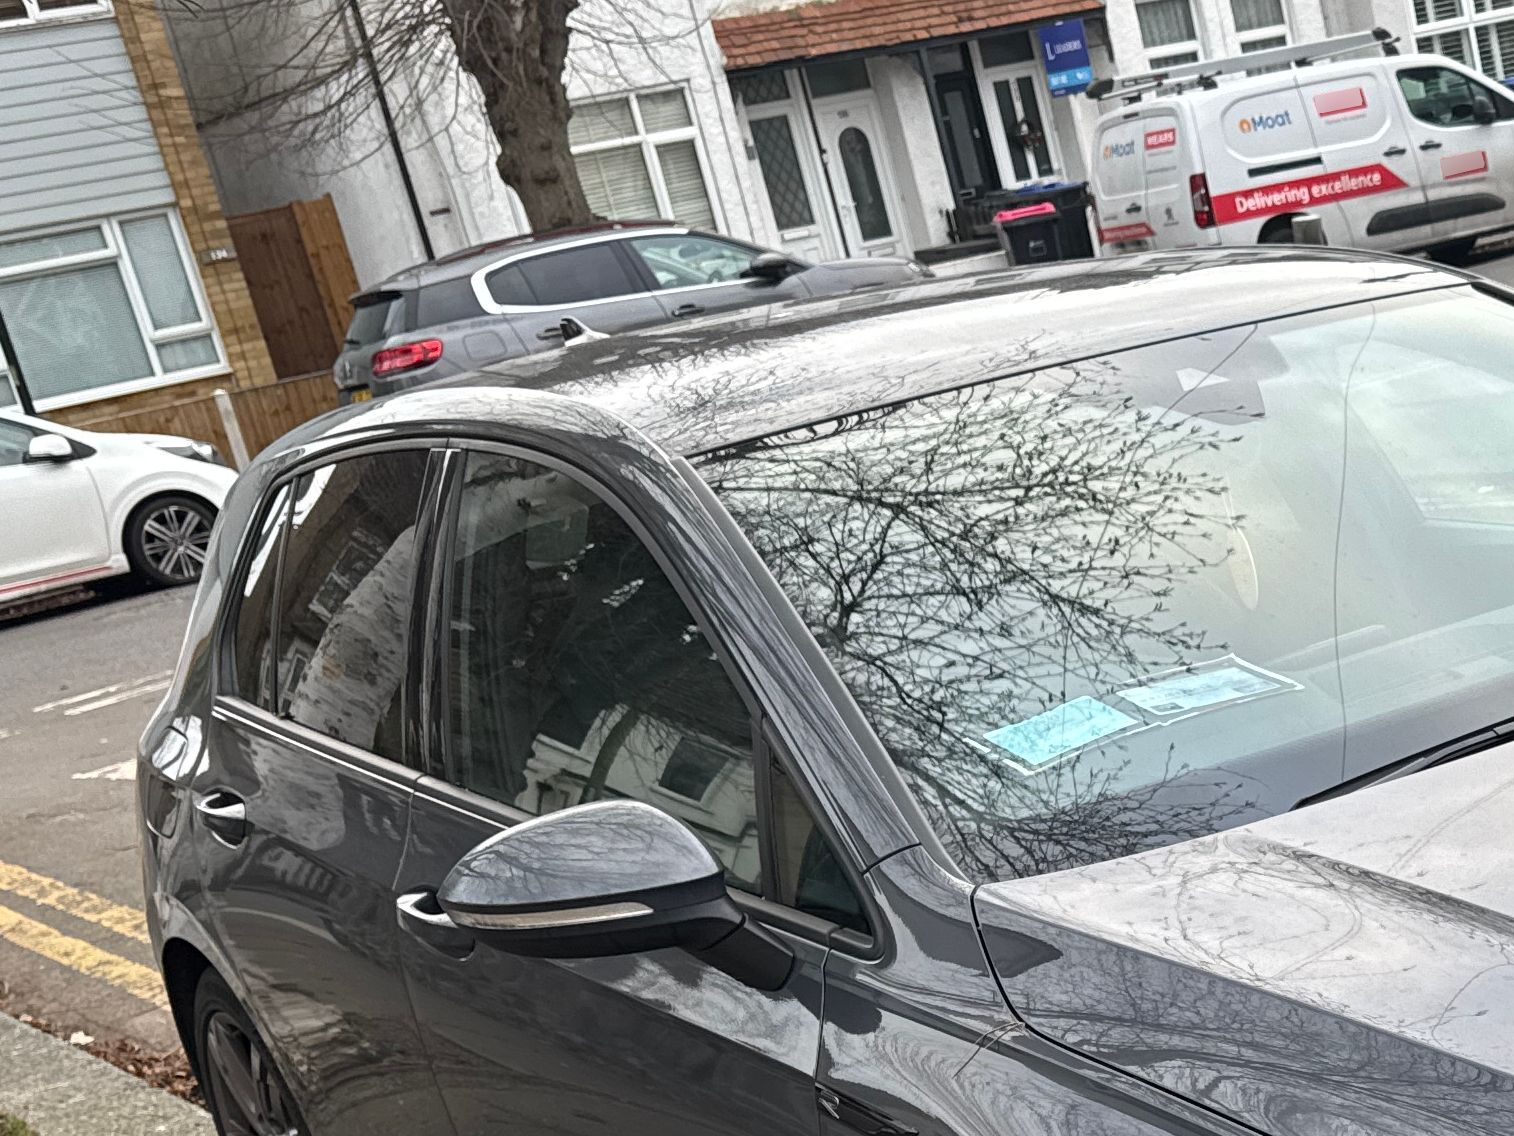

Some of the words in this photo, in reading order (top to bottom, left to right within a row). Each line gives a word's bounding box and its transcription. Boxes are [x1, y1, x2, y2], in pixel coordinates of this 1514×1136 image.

[1250, 110, 1293, 132] Moat
[1111, 139, 1136, 158] Moat
[1234, 184, 1310, 213] Delivering
[1311, 172, 1382, 199] excellence
